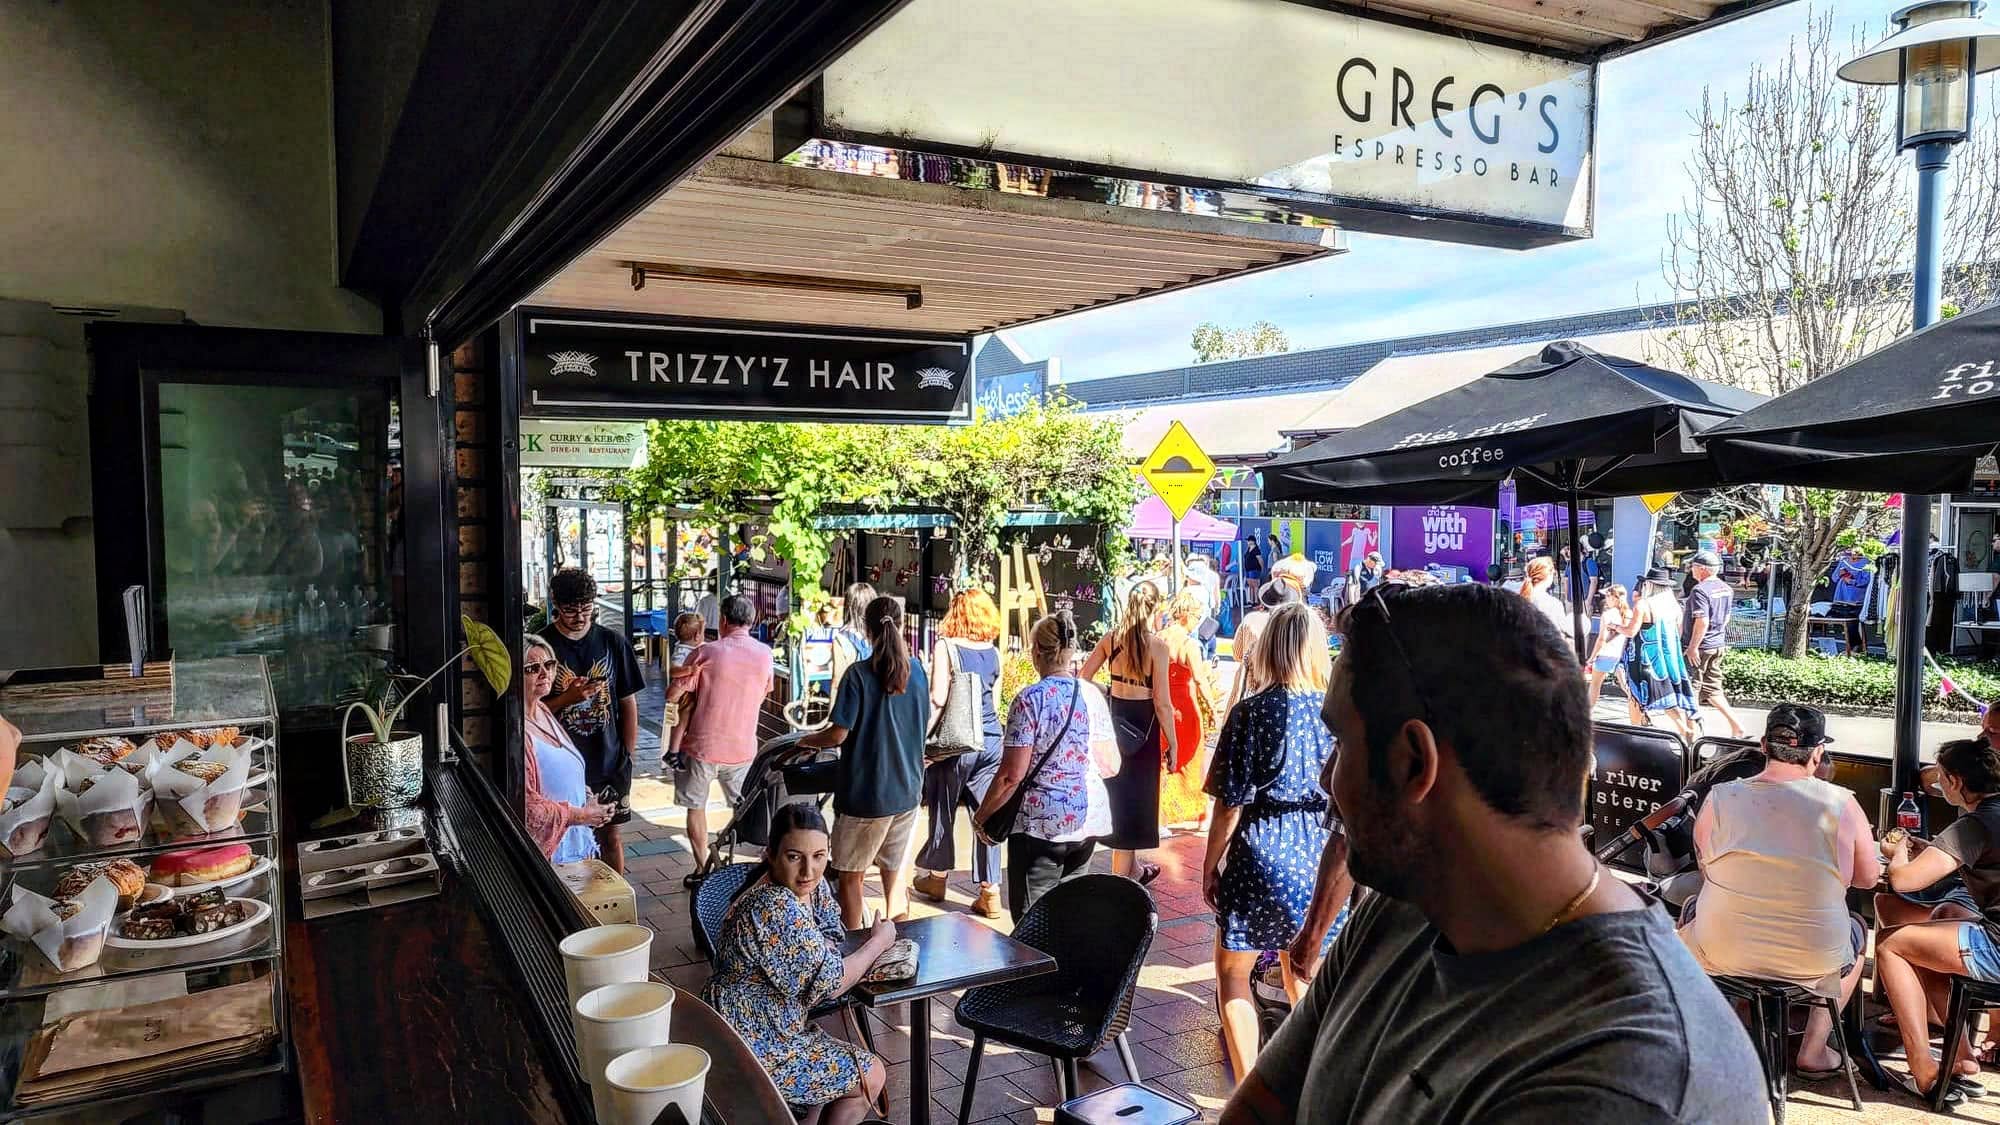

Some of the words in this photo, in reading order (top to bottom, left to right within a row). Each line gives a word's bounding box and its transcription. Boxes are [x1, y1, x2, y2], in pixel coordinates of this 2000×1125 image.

[1336, 57, 1560, 154] GREG'S
[1334, 134, 1488, 176] ESPRESSO
[1510, 162, 1558, 187] BAR
[624, 350, 789, 387] TRIZZY'Z
[809, 359, 896, 391] HAIR
[1943, 360, 2000, 382] fi
[1931, 380, 2000, 399] ro
[549, 433, 583, 442] CURRY
[584, 434, 592, 442] &
[588, 447, 630, 455] RESTAURANT
[1438, 447, 1504, 468] coffee
[1422, 510, 1467, 534] with
[1424, 532, 1463, 554] you
[1314, 554, 1334, 565] LOW
[1605, 769, 1662, 793] river
